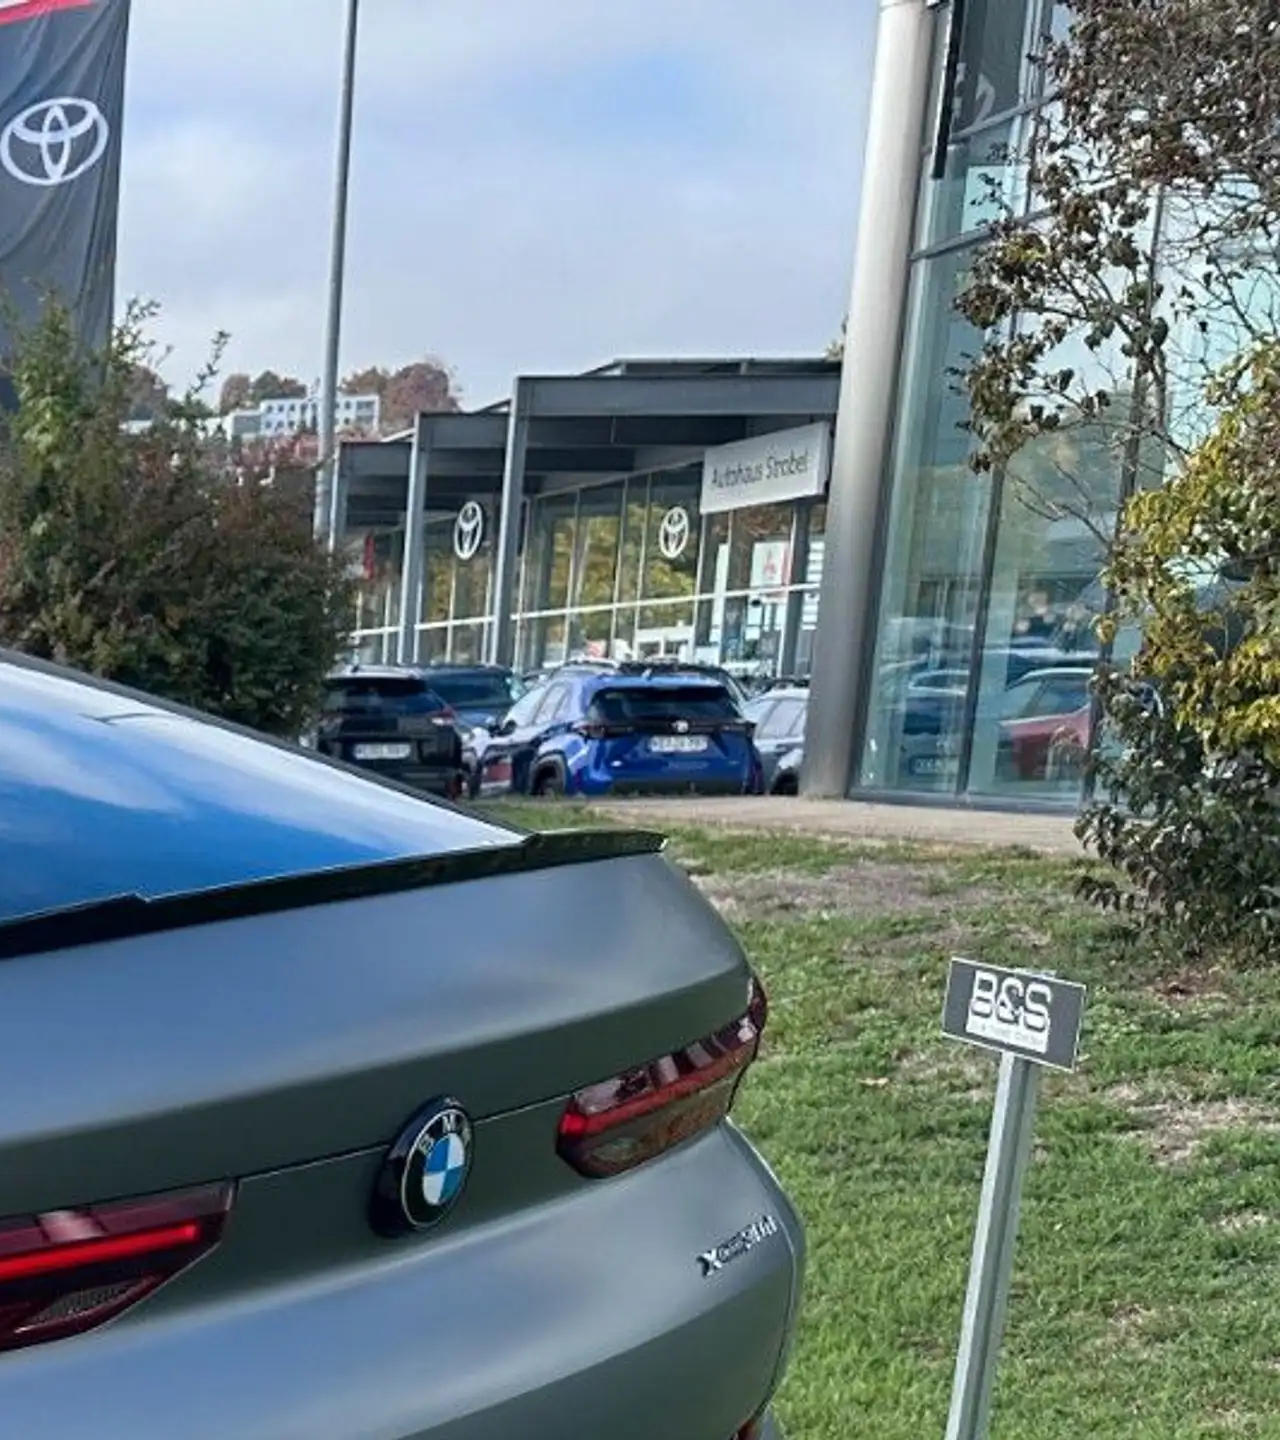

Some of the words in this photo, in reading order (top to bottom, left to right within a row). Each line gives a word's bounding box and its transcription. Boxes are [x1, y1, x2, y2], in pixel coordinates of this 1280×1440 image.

[711, 461, 763, 489] Autohaus
[766, 448, 809, 480] Strobel
[969, 970, 1052, 1034] B&S
